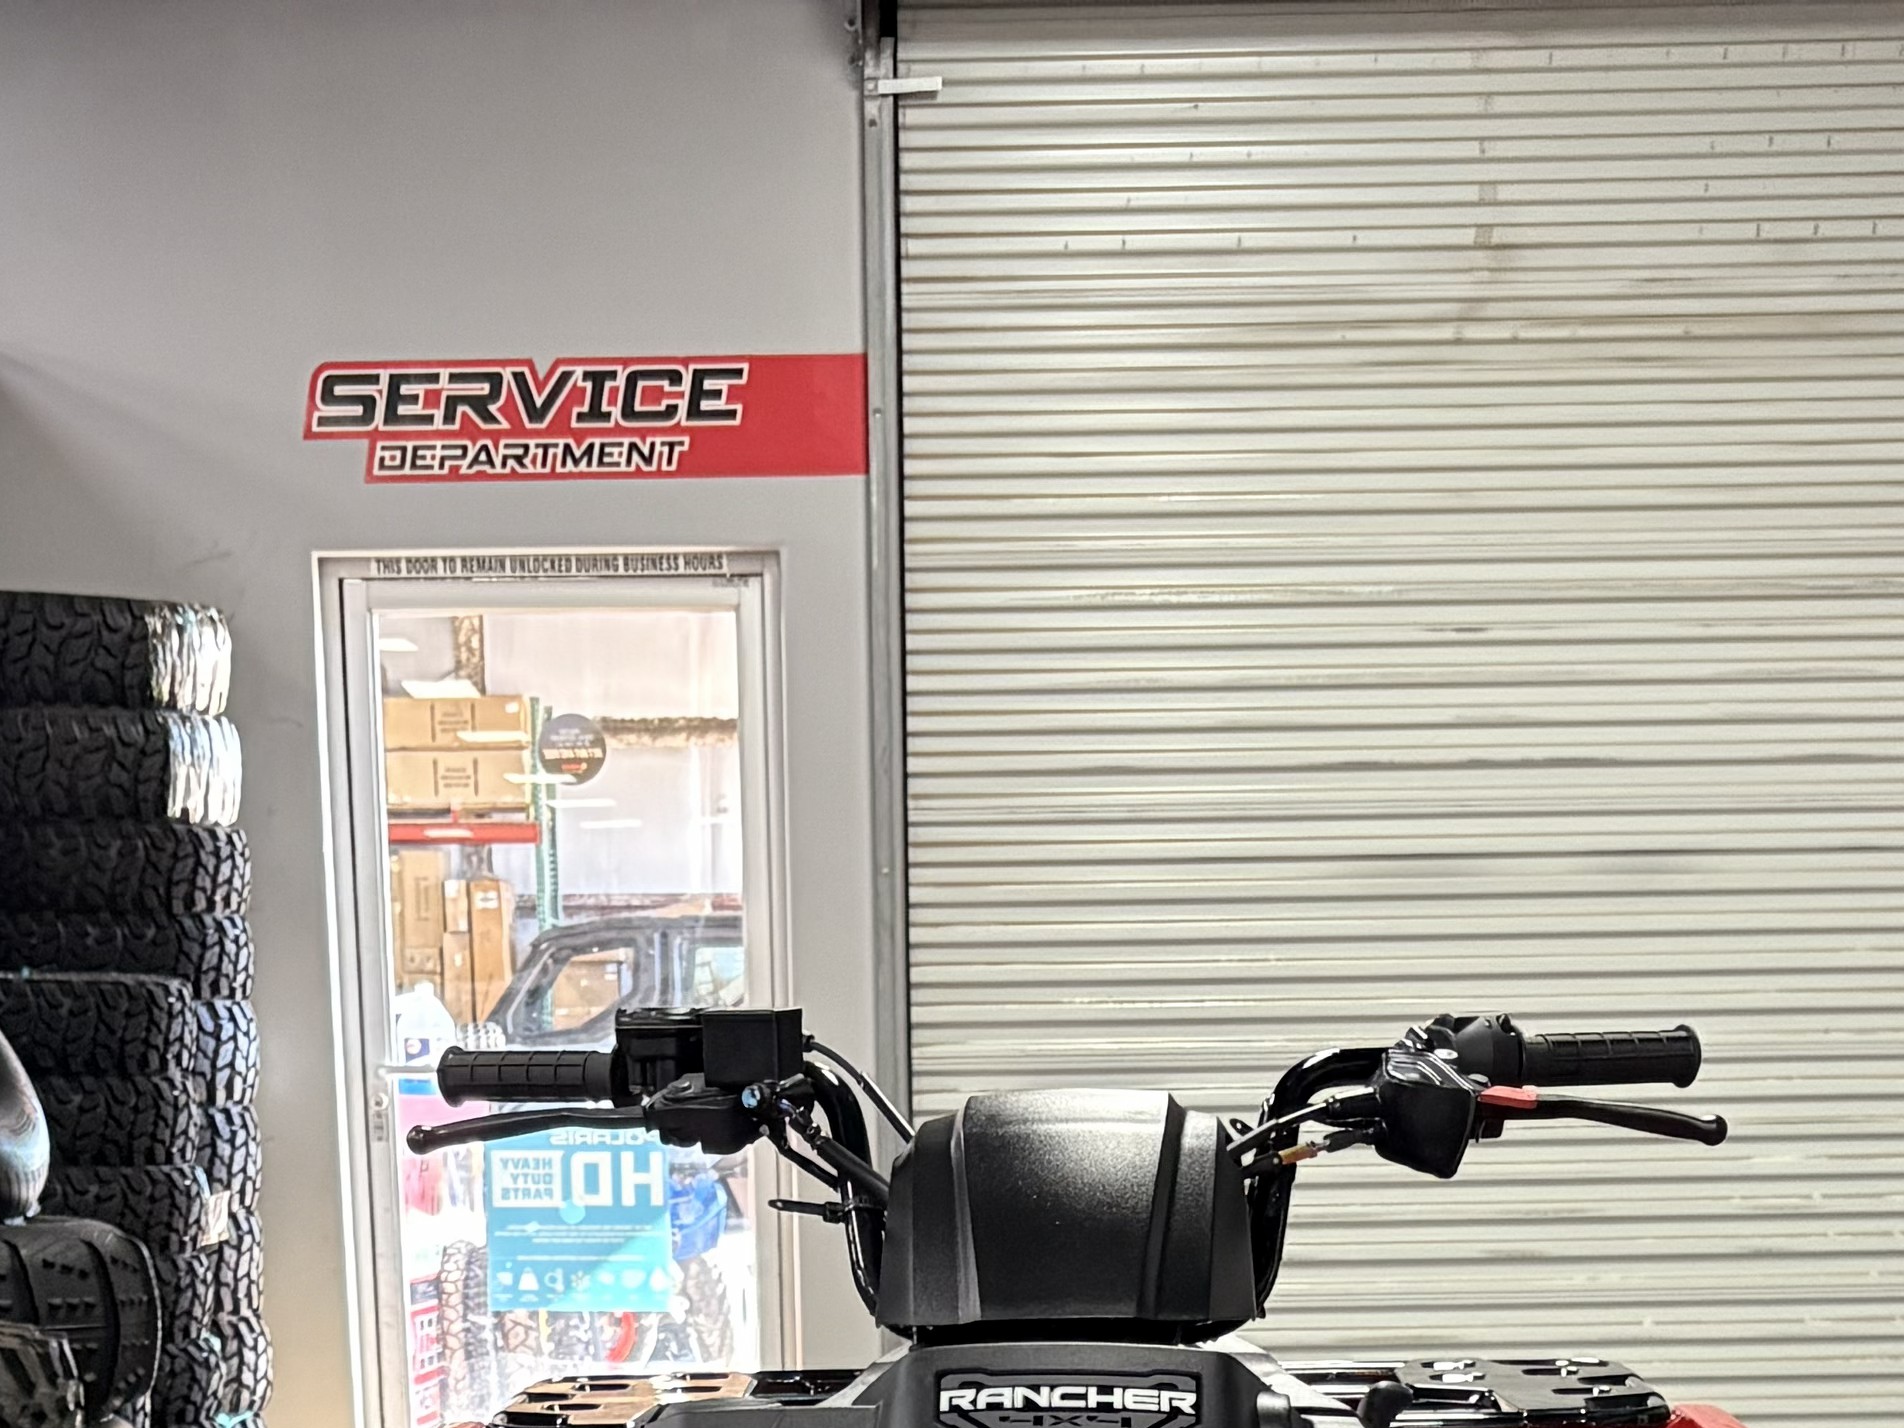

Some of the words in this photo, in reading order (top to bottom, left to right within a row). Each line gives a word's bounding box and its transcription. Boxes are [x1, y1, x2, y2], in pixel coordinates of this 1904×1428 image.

[314, 363, 746, 430] SERVICE
[377, 438, 687, 473] DEPARTMENT
[375, 557, 402, 576] THIS
[406, 557, 438, 575] DOOR
[441, 557, 457, 575] TO
[460, 556, 507, 574] REMAIN
[510, 556, 572, 574] UNLOCKED
[575, 555, 620, 573] DURING
[623, 554, 680, 573] BUSINESS
[683, 554, 724, 572] HOURS
[939, 1386, 1197, 1414] RANCHER
